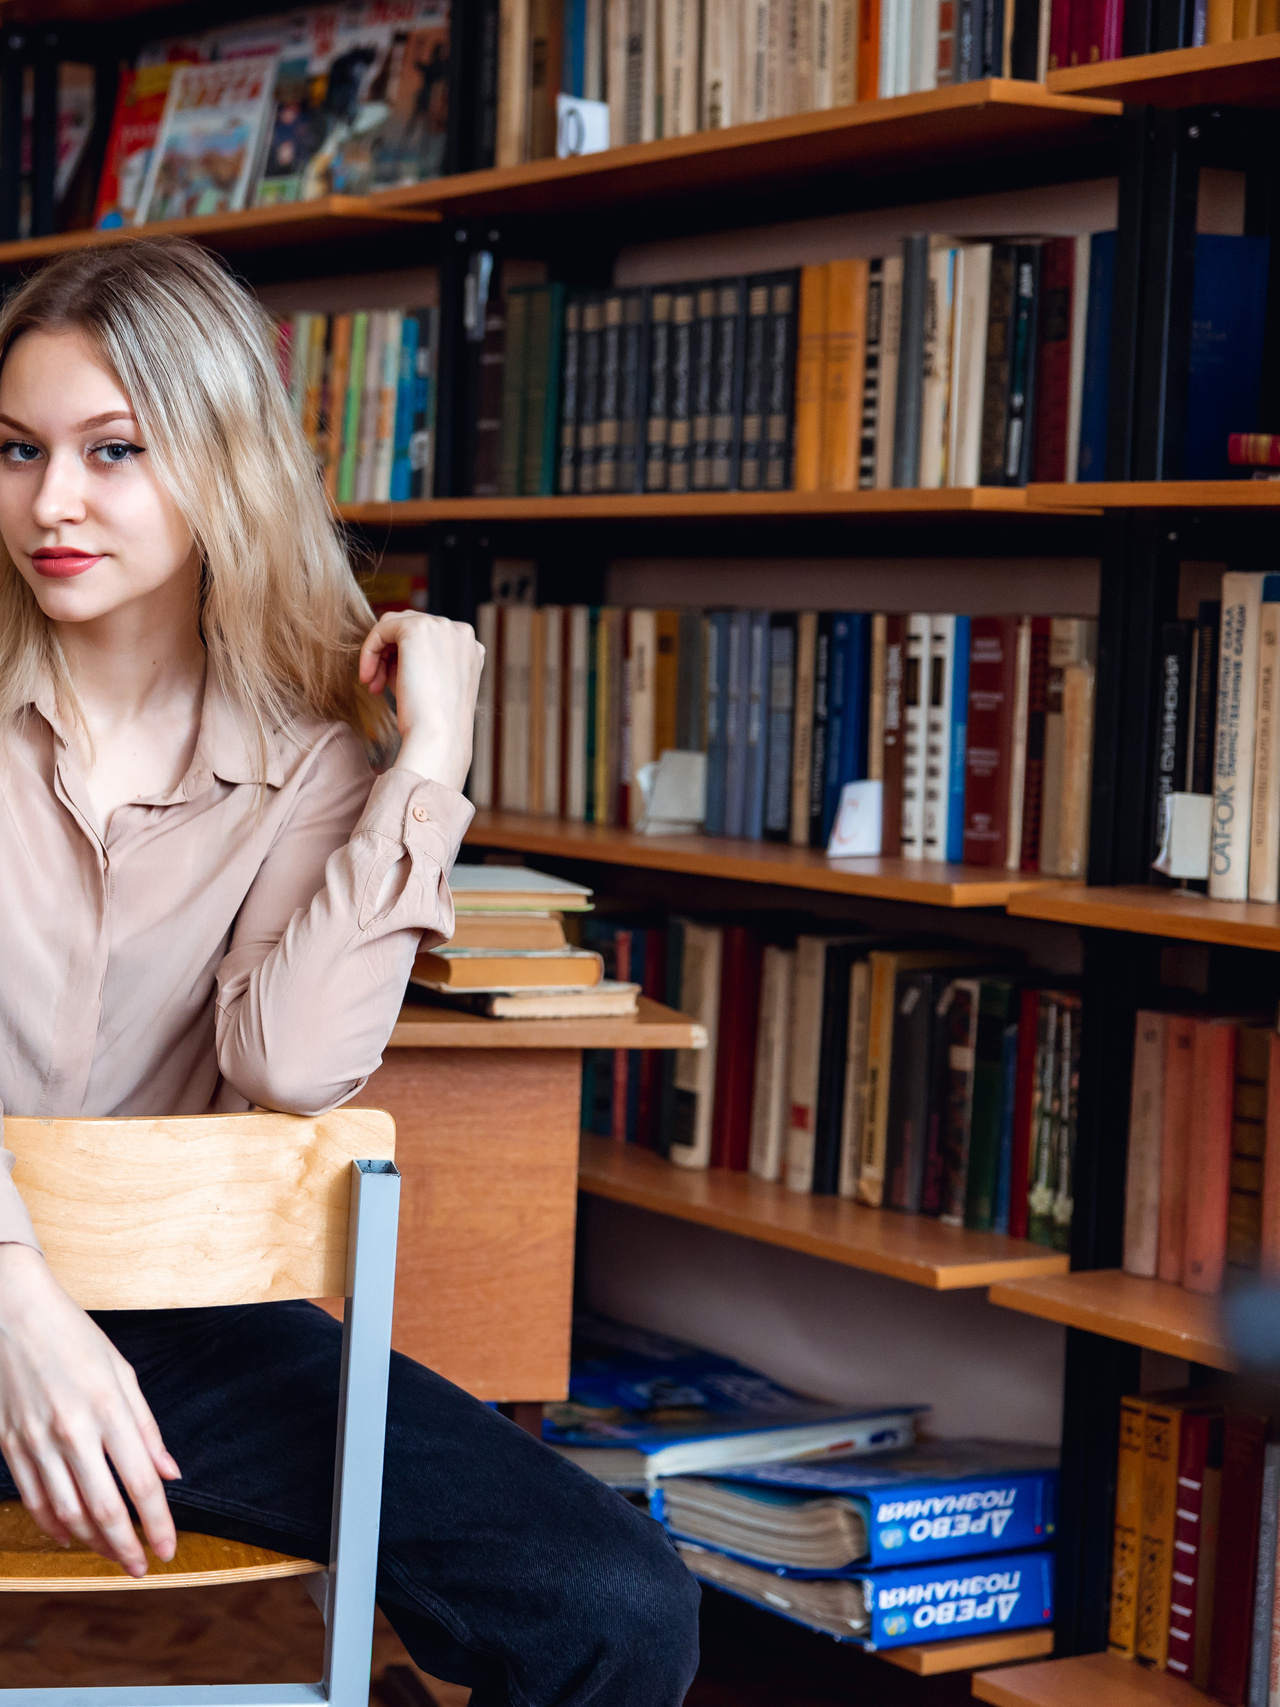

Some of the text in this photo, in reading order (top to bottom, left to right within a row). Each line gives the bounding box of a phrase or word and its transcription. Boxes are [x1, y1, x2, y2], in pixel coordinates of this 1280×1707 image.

[1212, 784, 1235, 876] САТ-ОК
[877, 1488, 1017, 1523] ПОЗНАНИЯ
[908, 1508, 1014, 1542] ДРЕВО
[878, 1570, 1021, 1610] ПОЗНАНИЯ
[912, 1591, 1021, 1629] ДРЕВО
